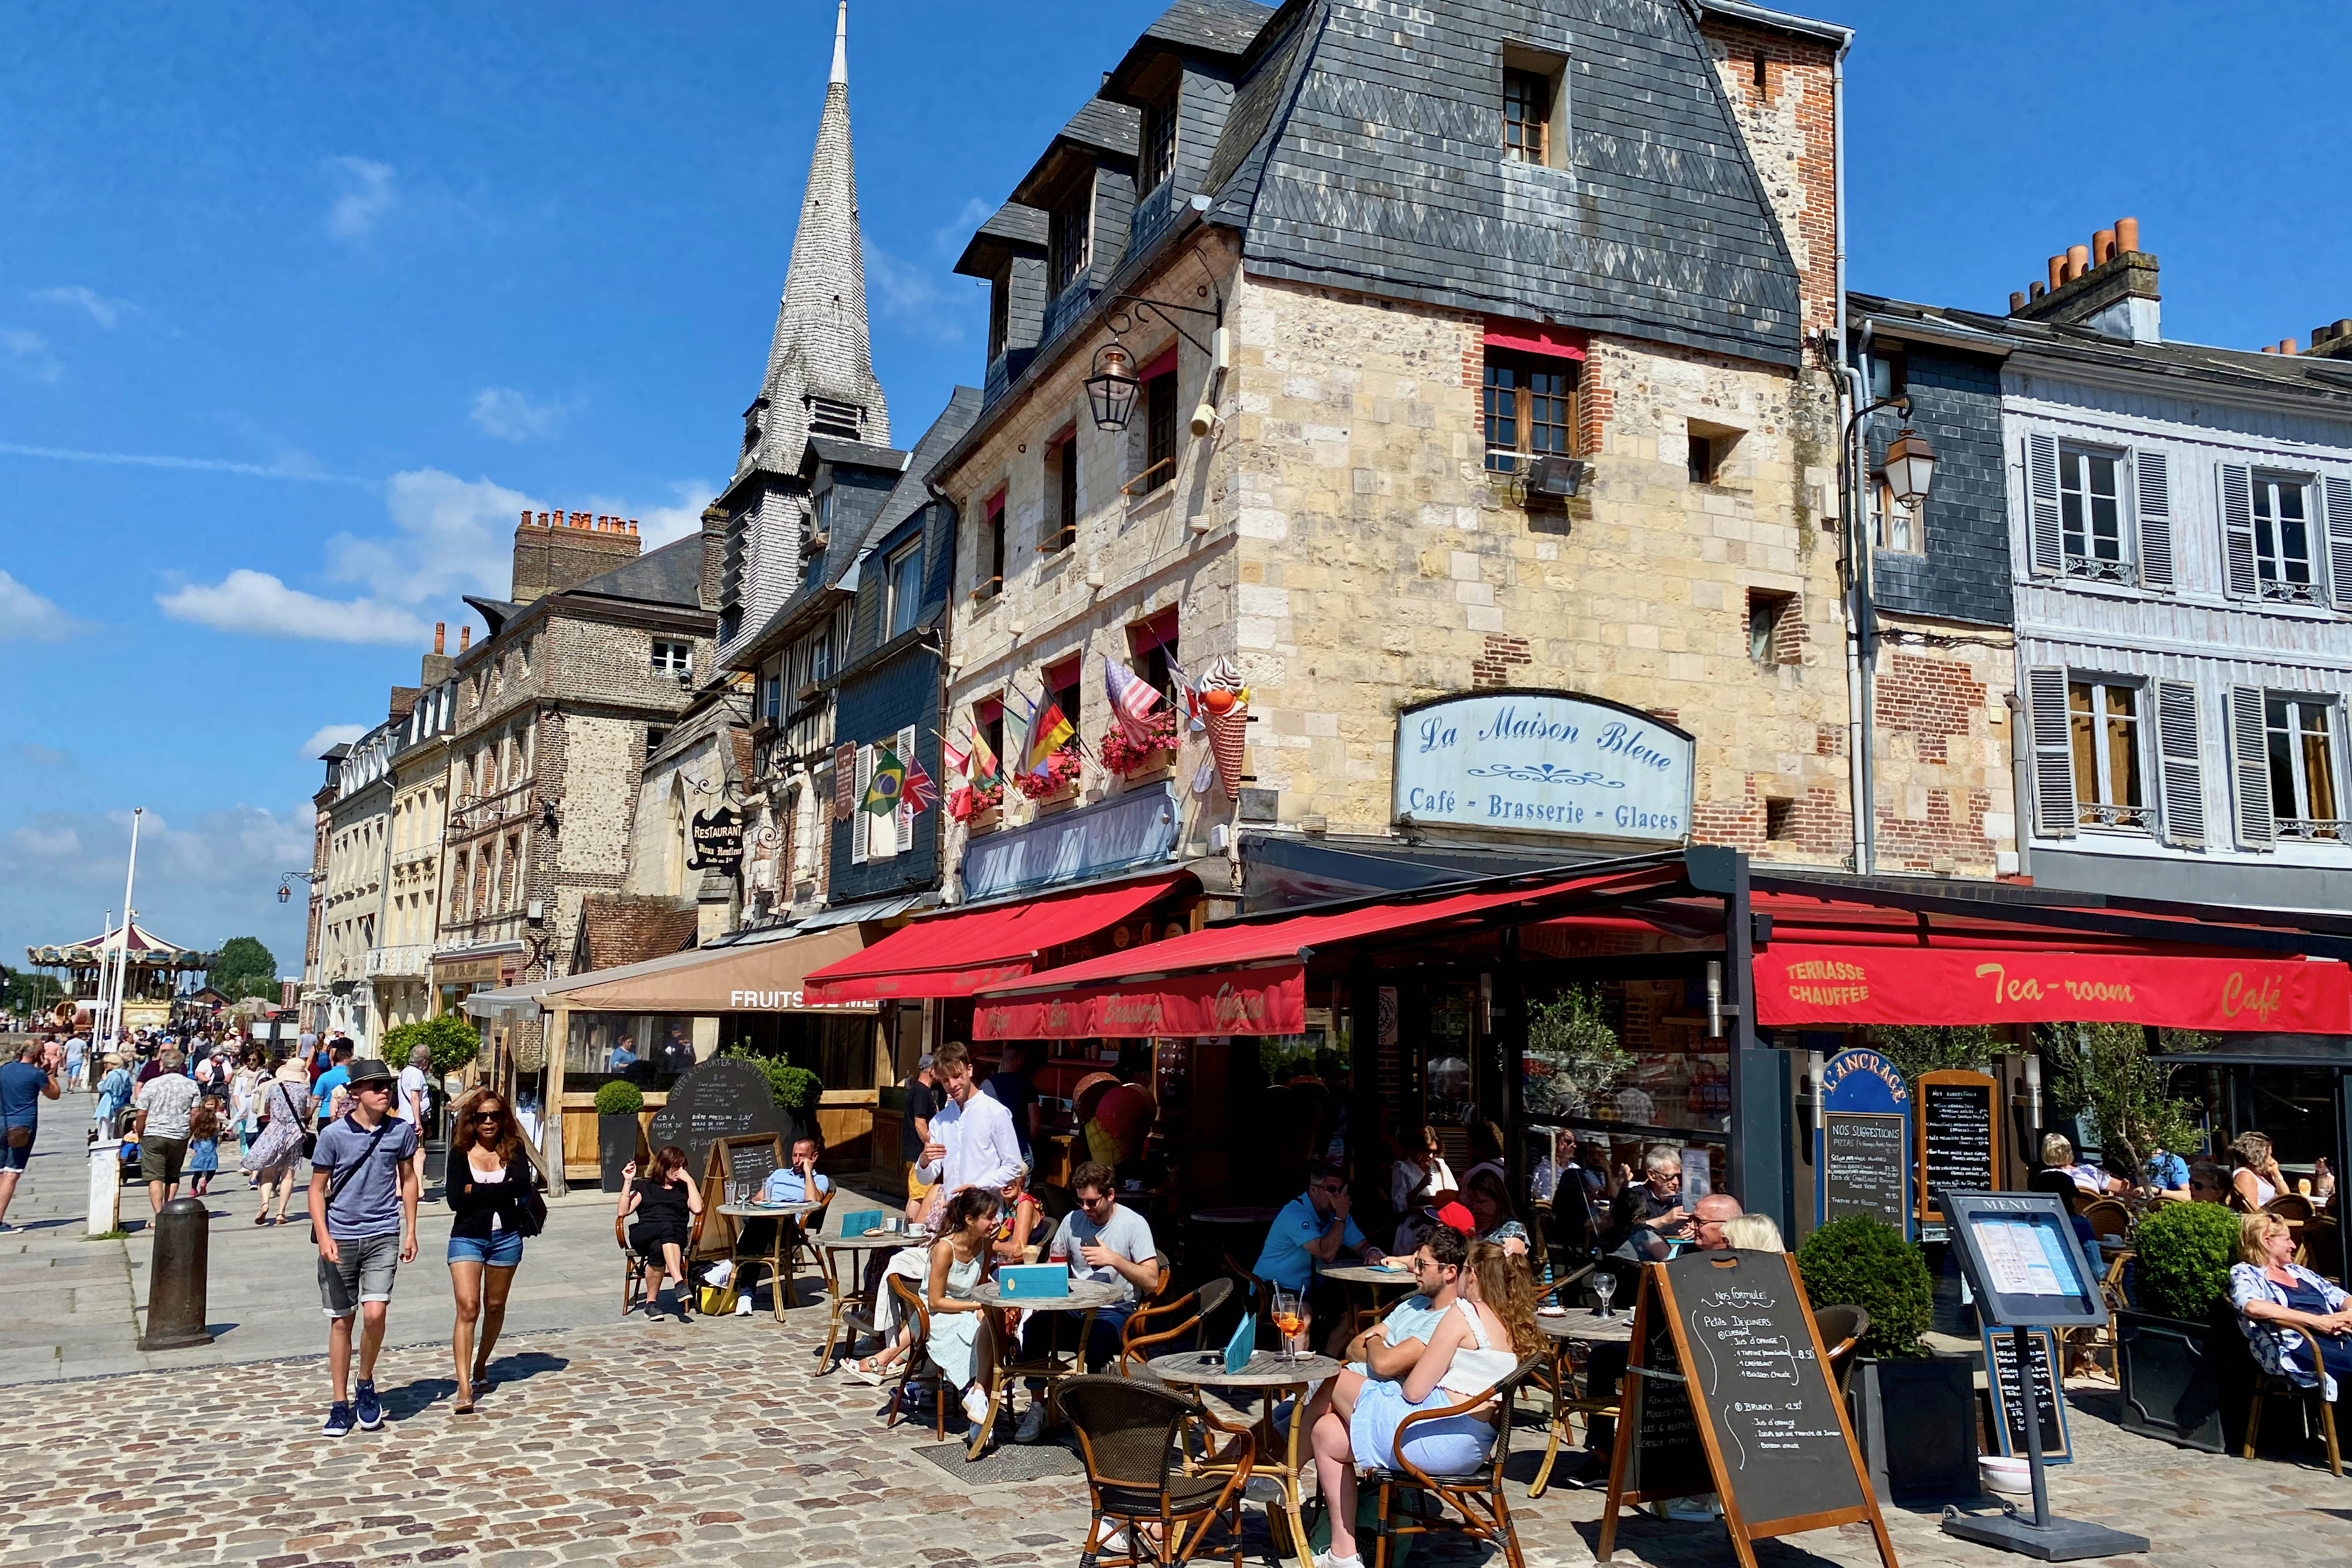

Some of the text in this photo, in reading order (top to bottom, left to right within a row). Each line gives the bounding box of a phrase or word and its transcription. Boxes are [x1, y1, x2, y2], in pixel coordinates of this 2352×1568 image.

[1420, 706, 1672, 772] La Maison Bleue
[1409, 787, 1455, 813] Café
[1488, 794, 1584, 823] Brasserie
[1615, 804, 1678, 830] Glaces
[694, 825, 743, 839] RESTAURANT
[716, 846, 743, 856] Honfleur
[1786, 960, 1866, 981] TERRASSE
[1975, 963, 2135, 1003] Tea-room
[731, 990, 805, 1008] FRUITS
[1788, 983, 1870, 1006] CHAUFFÉE
[2222, 971, 2283, 1024] Café
[1824, 1053, 1907, 1105] L'ANCRAGE
[1832, 1125, 1900, 1139] NOS SUGGESTIONS
[1833, 1138, 1854, 1147] PIZZAS
[1983, 1200, 2032, 1211] MENU
[1715, 1291, 1731, 1300] Nos
[1703, 1315, 1727, 1327] Petits
[1744, 1402, 1773, 1411] BRUNCH
